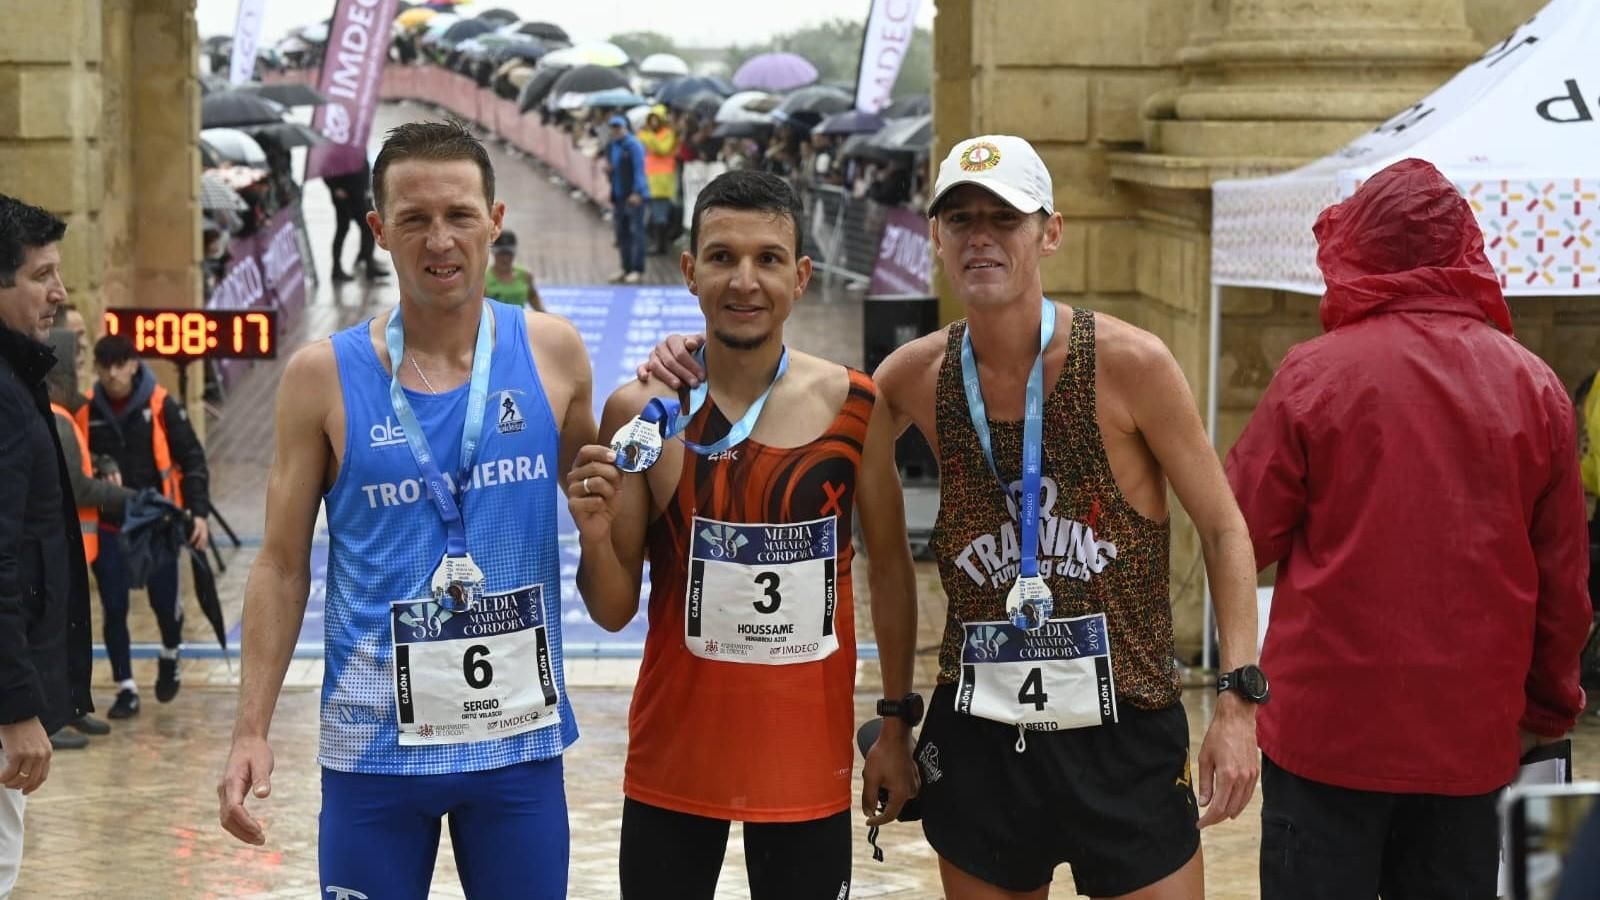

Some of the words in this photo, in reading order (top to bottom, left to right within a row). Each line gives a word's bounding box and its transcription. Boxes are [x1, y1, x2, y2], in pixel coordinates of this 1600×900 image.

[764, 525, 813, 541] MEDIA
[752, 571, 782, 614] 3
[412, 615, 442, 639] 59
[737, 624, 794, 635] HOUSSAME
[782, 642, 819, 654] IMDECO
[463, 645, 493, 690] 6
[1018, 667, 1048, 711] 4
[463, 698, 499, 712] SERGIO
